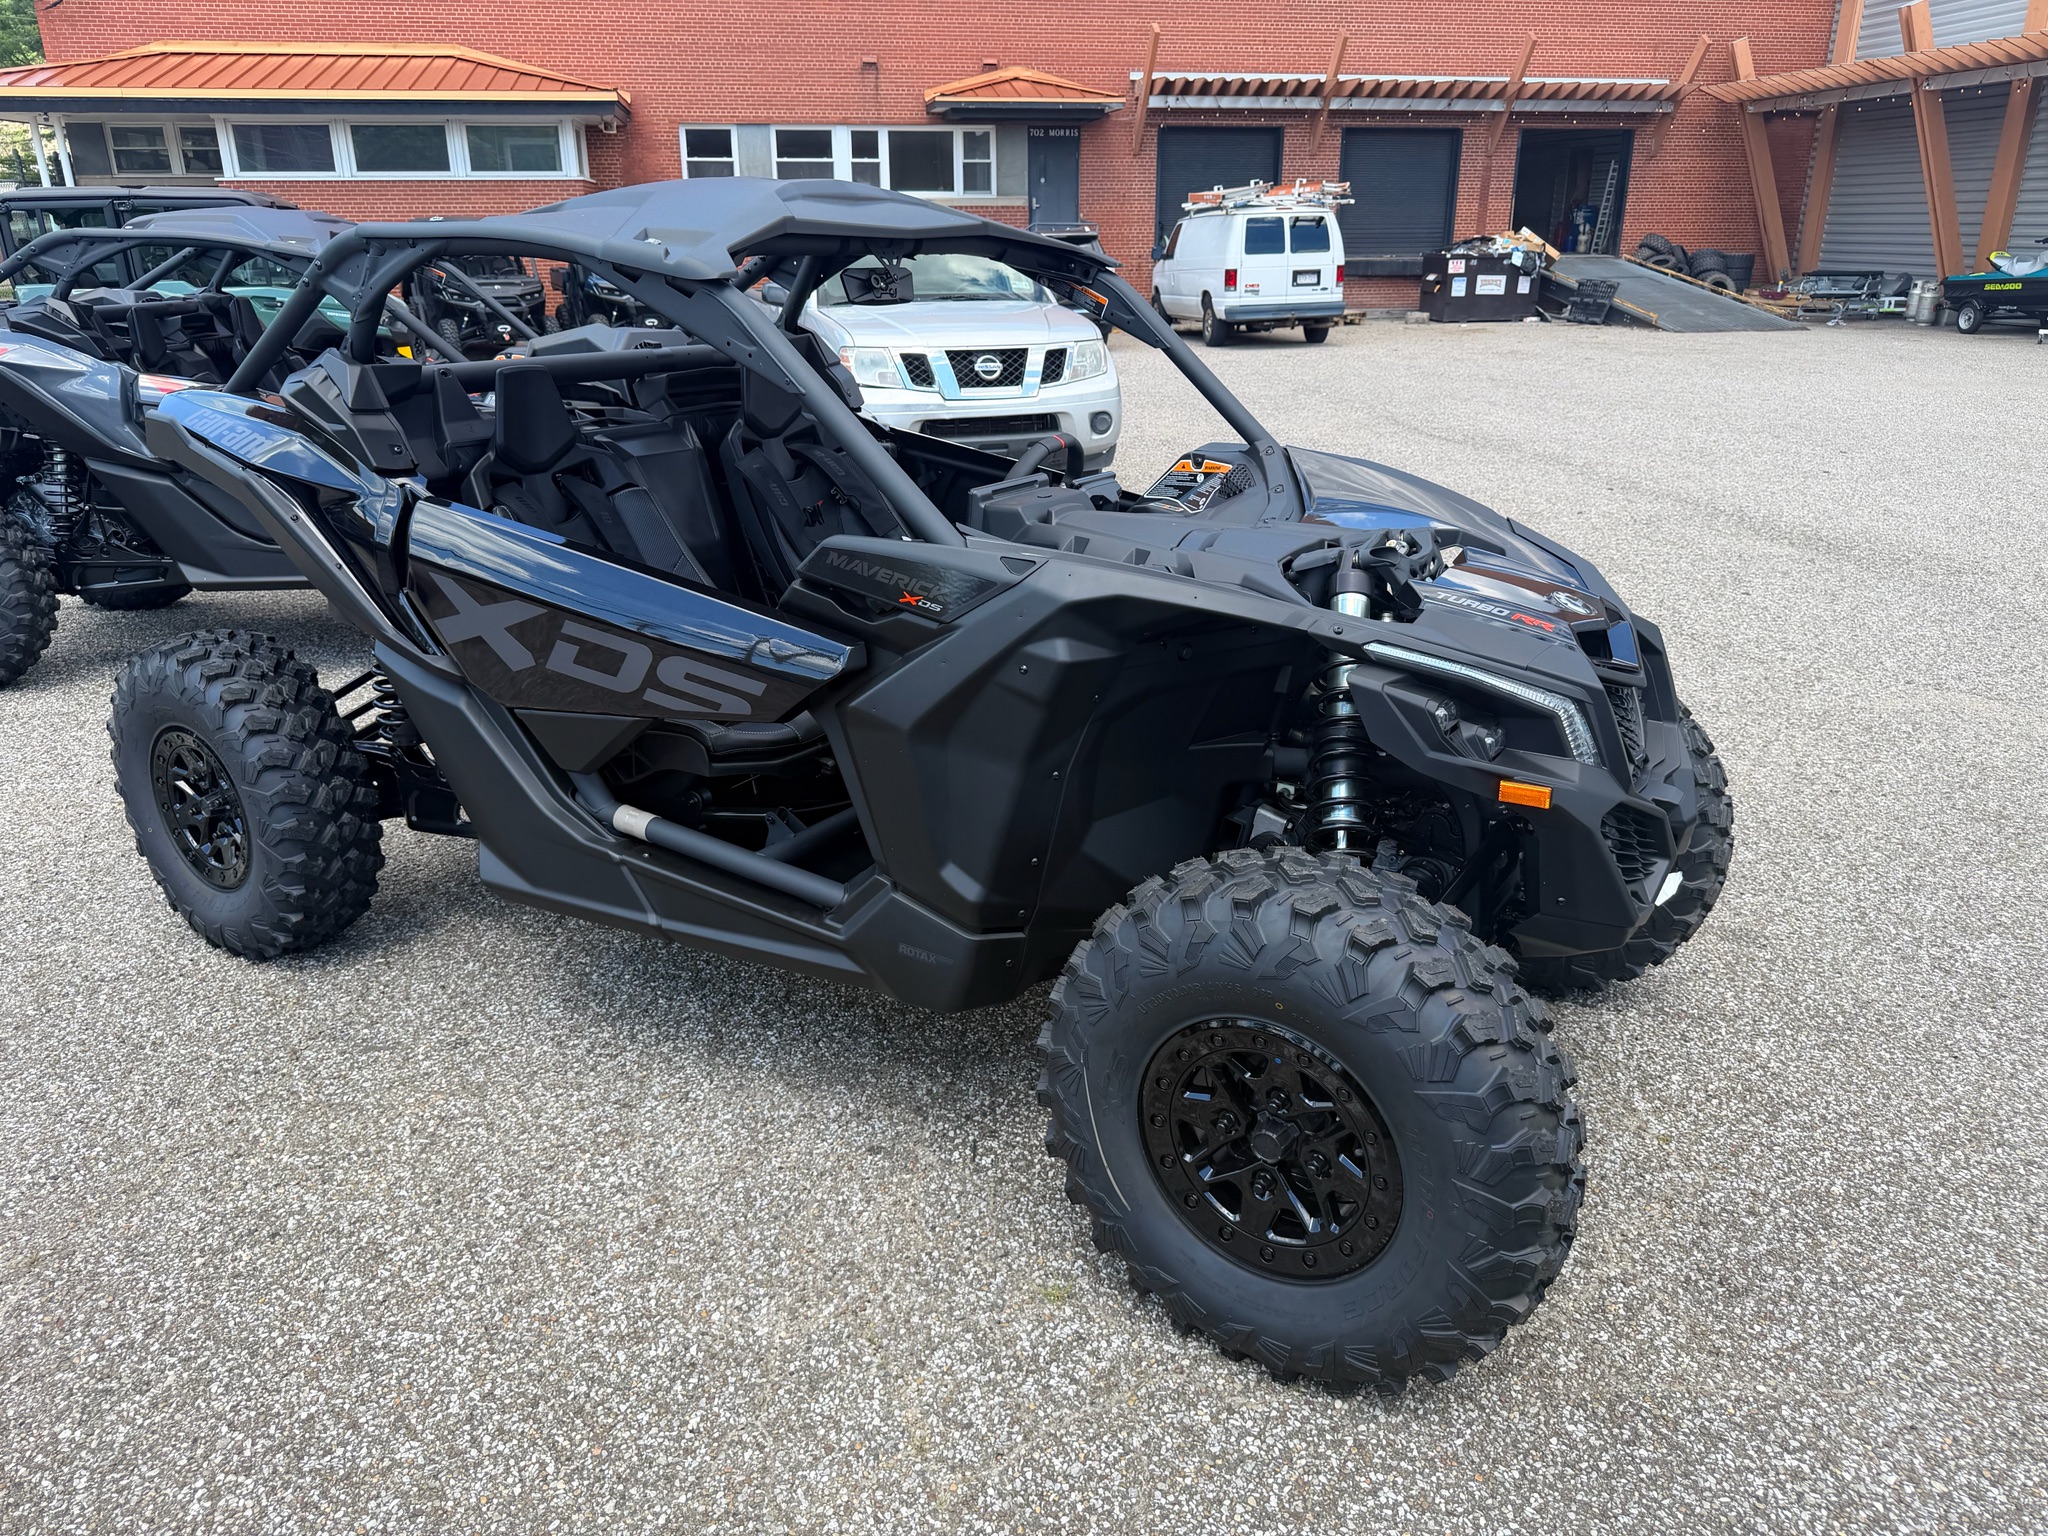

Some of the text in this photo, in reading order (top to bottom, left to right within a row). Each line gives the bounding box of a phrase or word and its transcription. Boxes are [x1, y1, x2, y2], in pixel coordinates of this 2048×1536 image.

[1029, 128, 1079, 137] 702 MORRIS
[183, 407, 273, 459] can-am
[825, 551, 950, 604] MAVERICK
[899, 591, 944, 612] XDS
[1436, 591, 1556, 633] TURBO RR
[428, 571, 768, 715] XDS
[899, 943, 937, 964] ROTAX
